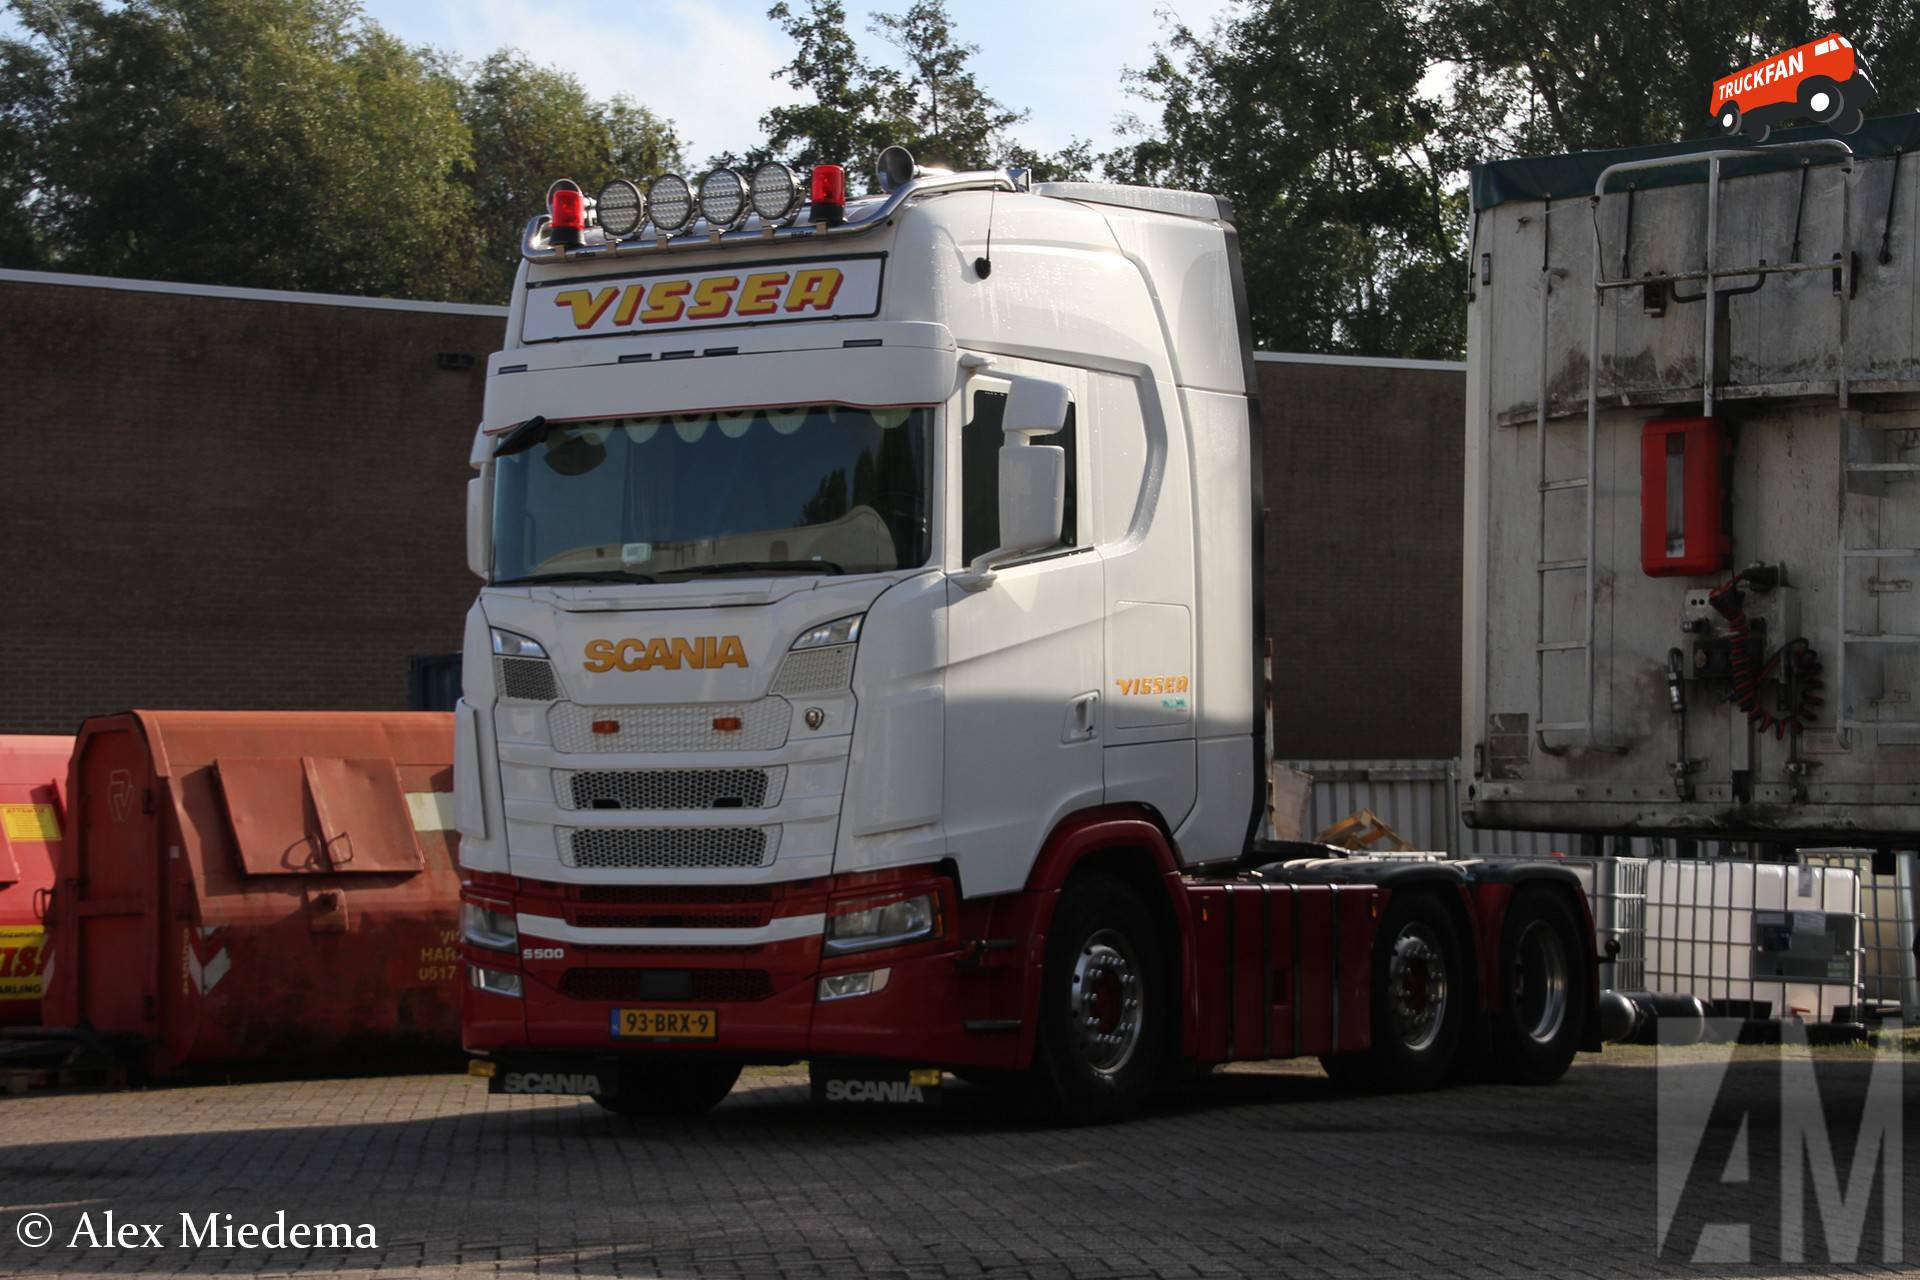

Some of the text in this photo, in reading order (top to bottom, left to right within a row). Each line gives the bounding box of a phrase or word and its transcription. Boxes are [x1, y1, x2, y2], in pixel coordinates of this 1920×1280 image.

[555, 268, 844, 329] VISSER
[583, 635, 749, 673] SCANIA
[1116, 675, 1189, 696] VISSER
[523, 947, 564, 960] S500
[626, 1012, 709, 1033] 93-BRX-9
[504, 1072, 601, 1095] SCANIA
[825, 1080, 924, 1103] SCANIA
